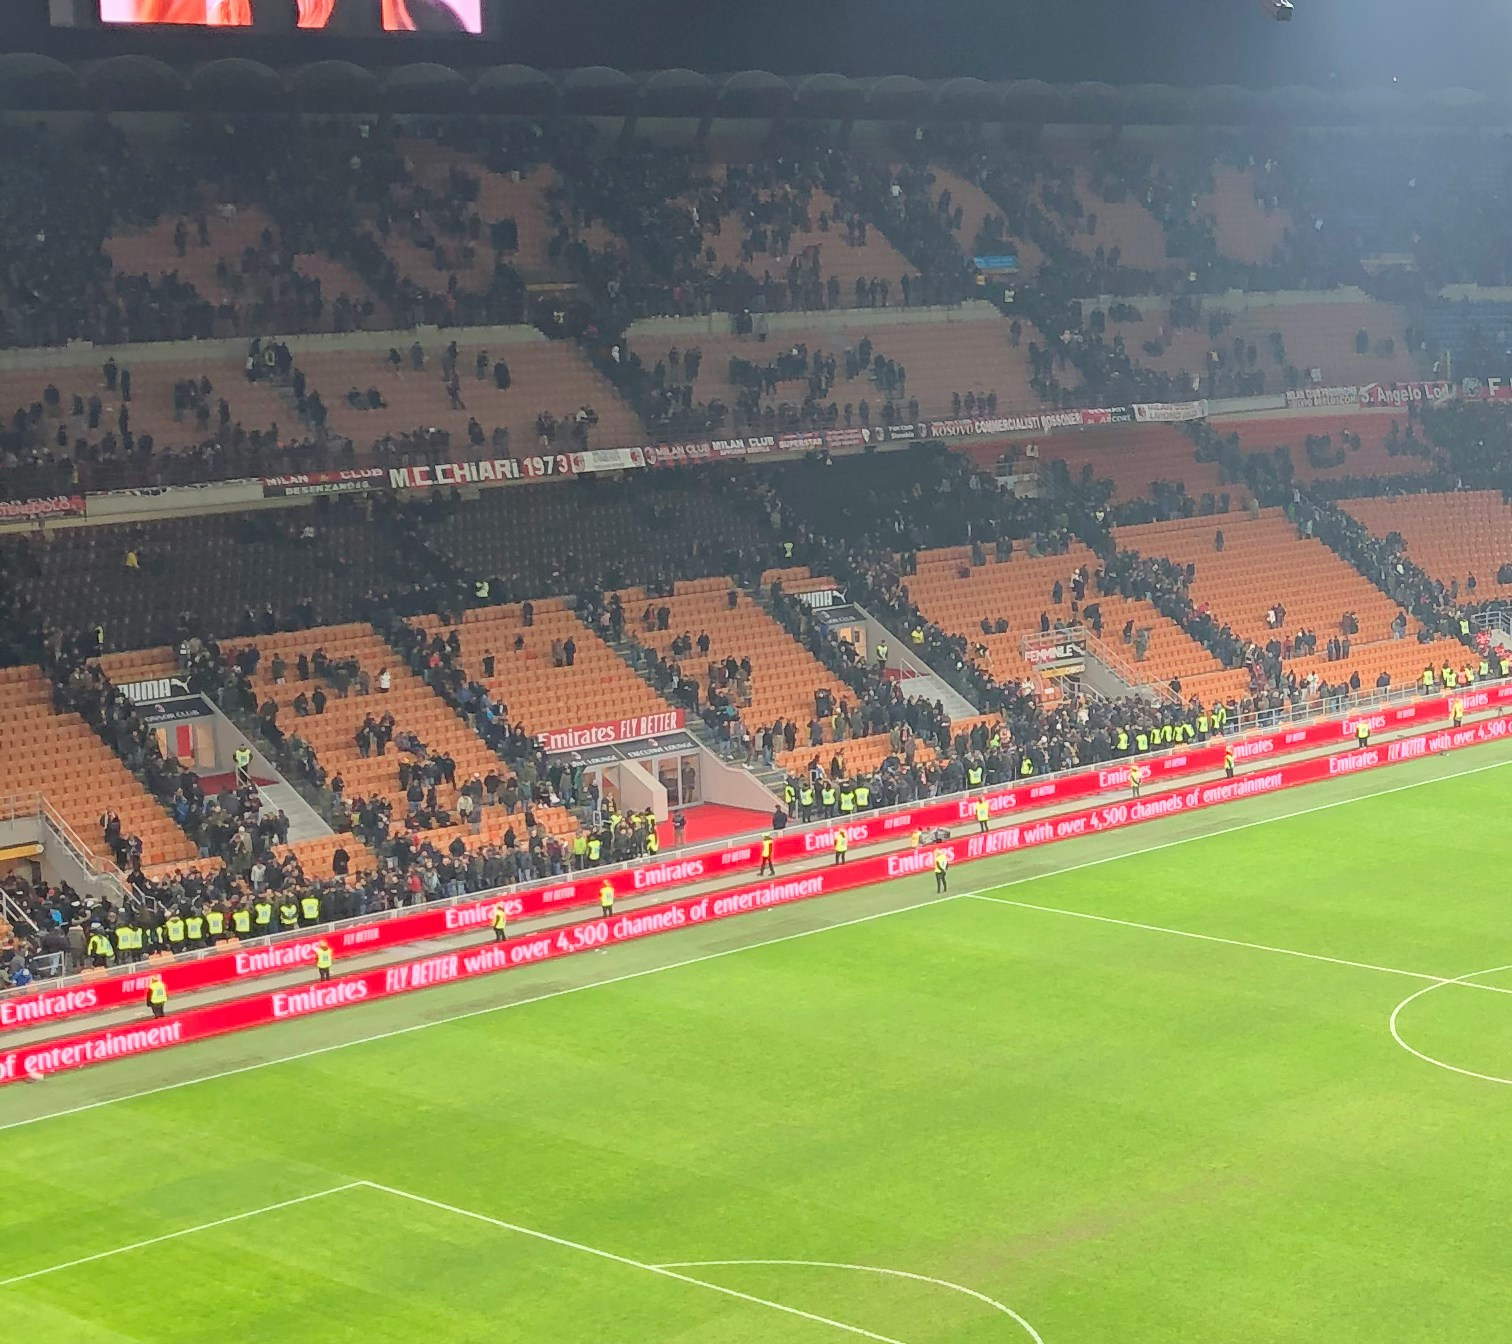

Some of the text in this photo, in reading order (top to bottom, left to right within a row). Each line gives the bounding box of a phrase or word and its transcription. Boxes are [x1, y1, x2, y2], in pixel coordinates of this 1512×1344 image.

[1377, 386, 1422, 407] Angelo
[712, 439, 745, 450] MILAN
[748, 436, 775, 447] CLUB
[264, 474, 309, 487] MILAN
[1448, 692, 1488, 711] Eirates
[537, 711, 677, 751] Emirates FLY BETTER
[1329, 749, 1379, 774] Emirates
[1387, 744, 1401, 761] FLY
[1401, 737, 1427, 759] BETTER
[1429, 730, 1450, 751] with
[1453, 728, 1476, 745] over
[1477, 720, 1507, 740] 4,500
[1099, 766, 1150, 787] Emires
[967, 836, 984, 857] FLY
[986, 827, 1020, 853] BETTER
[1024, 822, 1054, 845] with
[1057, 815, 1087, 835] over
[1090, 805, 1128, 830] 4,500
[1131, 793, 1183, 820] channels
[1185, 787, 1200, 806] of
[1203, 772, 1283, 803] entertainment
[634, 858, 704, 889] Emirates
[445, 897, 523, 929] Emiraes
[236, 941, 319, 975] Emirates
[272, 875, 823, 1017] Emirates FLY BETTER with over 4,500 channels of entertainment
[1, 988, 97, 1025] Emirates
[24, 1020, 182, 1074] entertainment
